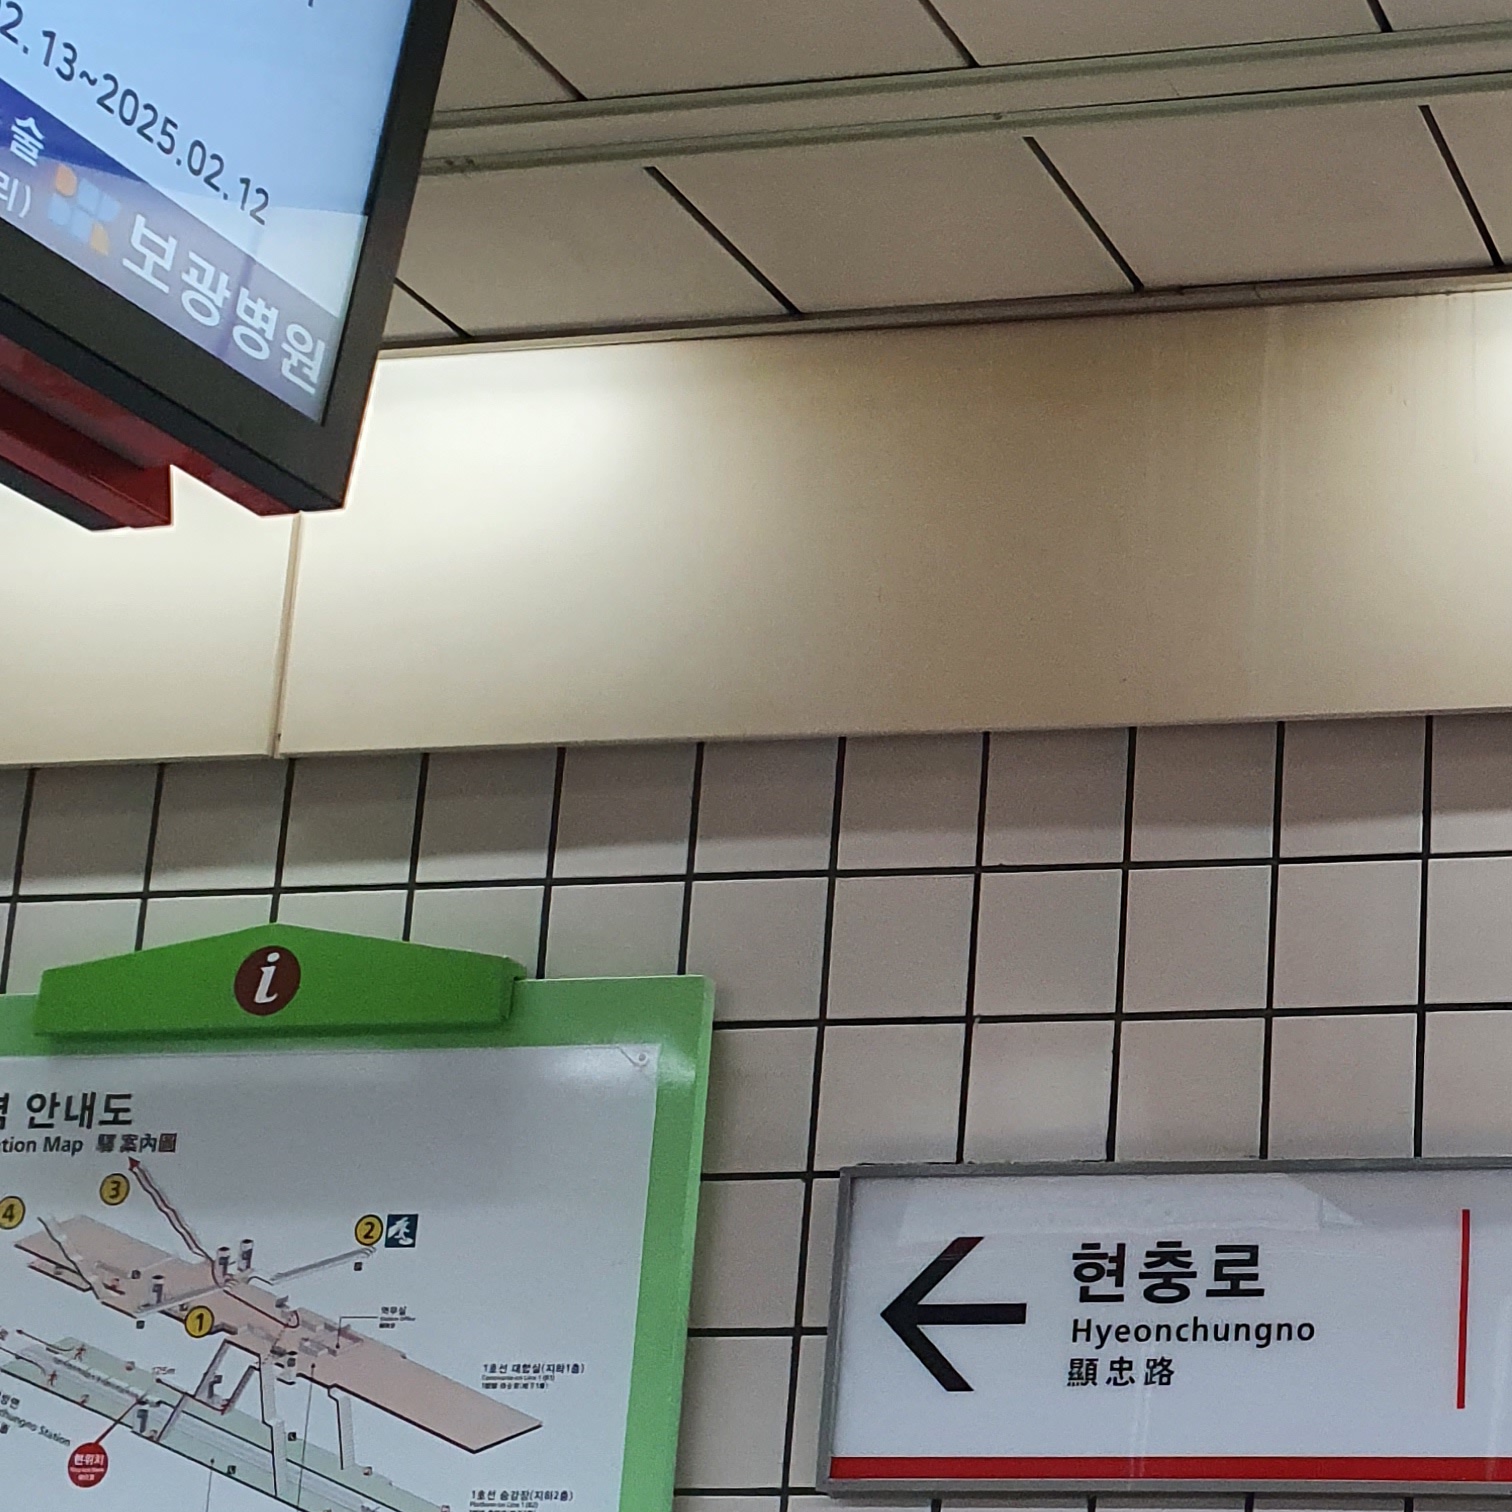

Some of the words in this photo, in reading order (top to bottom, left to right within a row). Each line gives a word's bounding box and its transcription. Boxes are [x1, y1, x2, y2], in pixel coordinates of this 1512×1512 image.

[122, 213, 326, 396] 보광병원
[26, 1091, 134, 1130] 안내도
[43, 1136, 84, 1156] Map
[1072, 1241, 1266, 1304] 현충로
[1071, 1316, 1315, 1350] Hyeonchungno
[1067, 1356, 1175, 1388] 顯忠路
